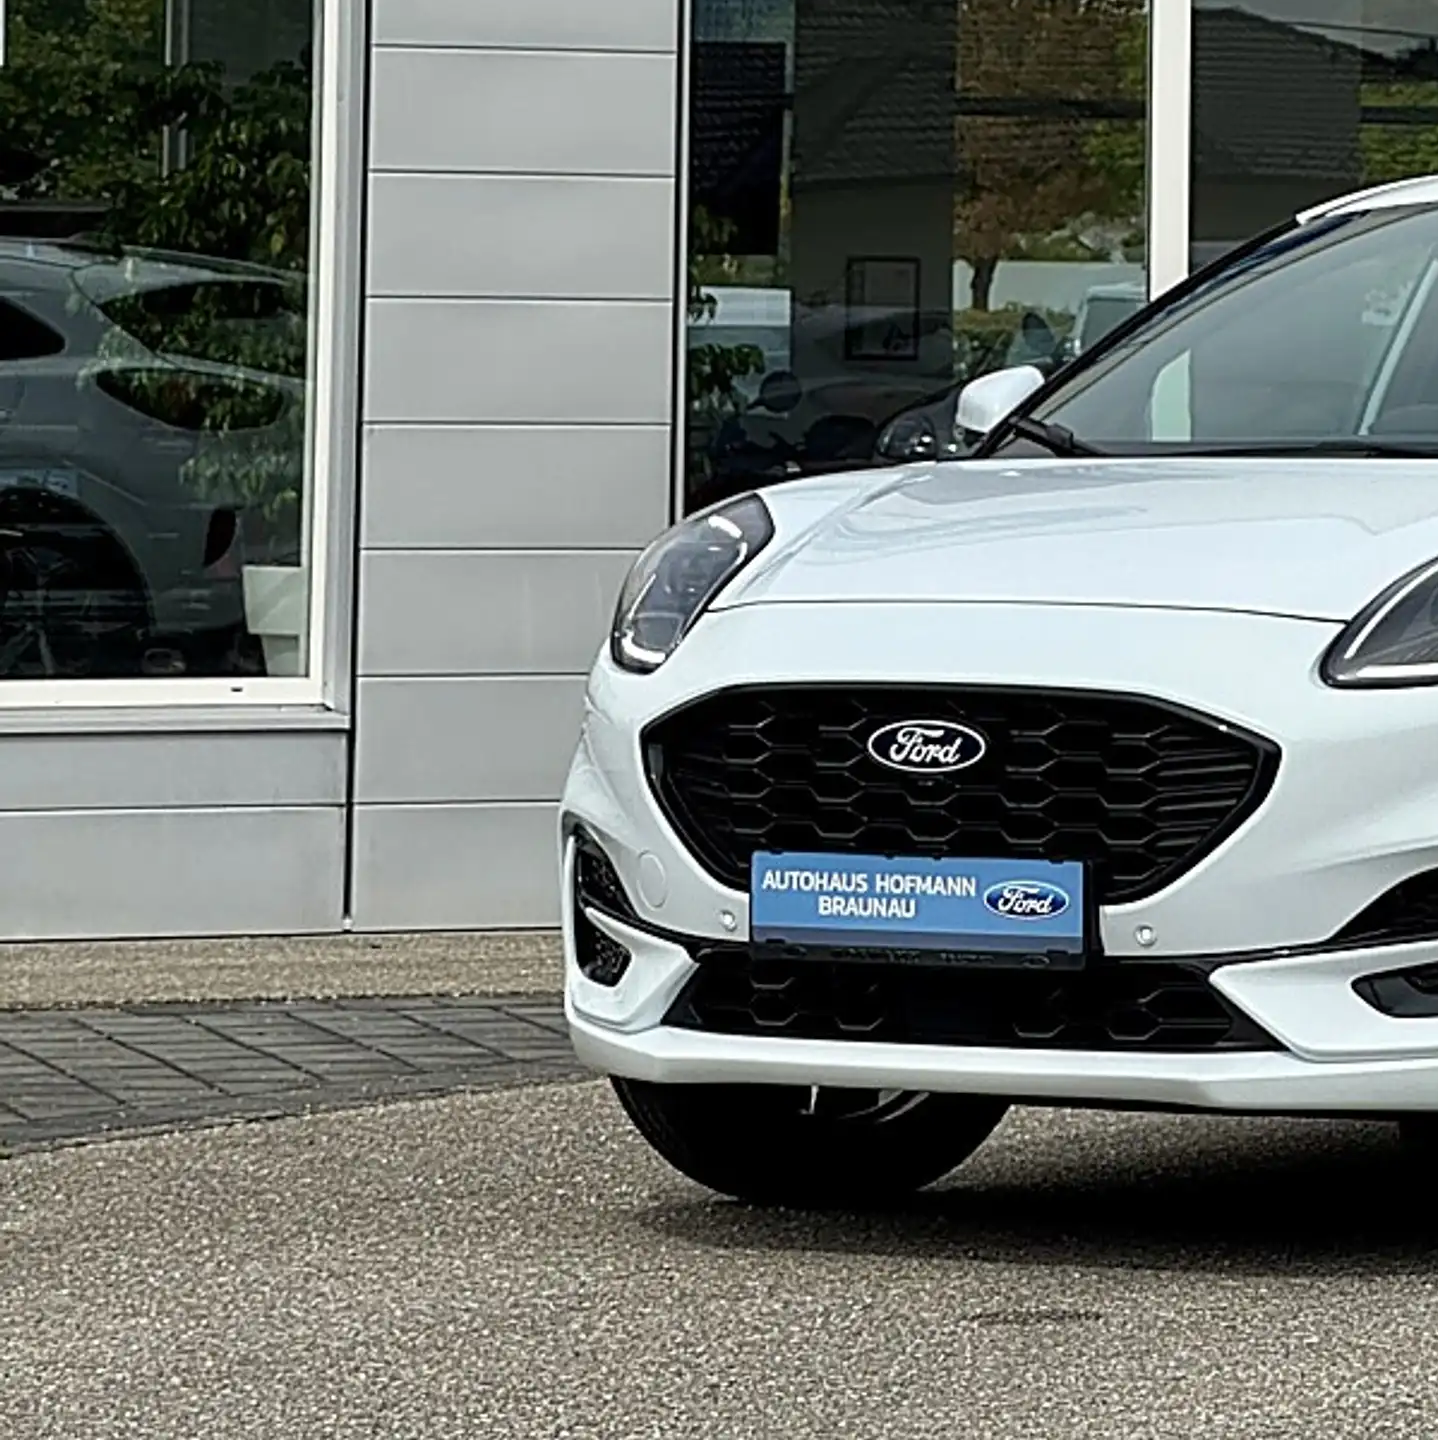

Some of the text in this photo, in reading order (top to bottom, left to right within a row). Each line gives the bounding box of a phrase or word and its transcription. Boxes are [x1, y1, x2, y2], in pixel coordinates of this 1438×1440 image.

[889, 727, 963, 763] Ford
[762, 869, 978, 897] AUTOHAUS HOFMANN
[818, 895, 916, 918] BRAUNAU
[997, 885, 1054, 914] Ford
